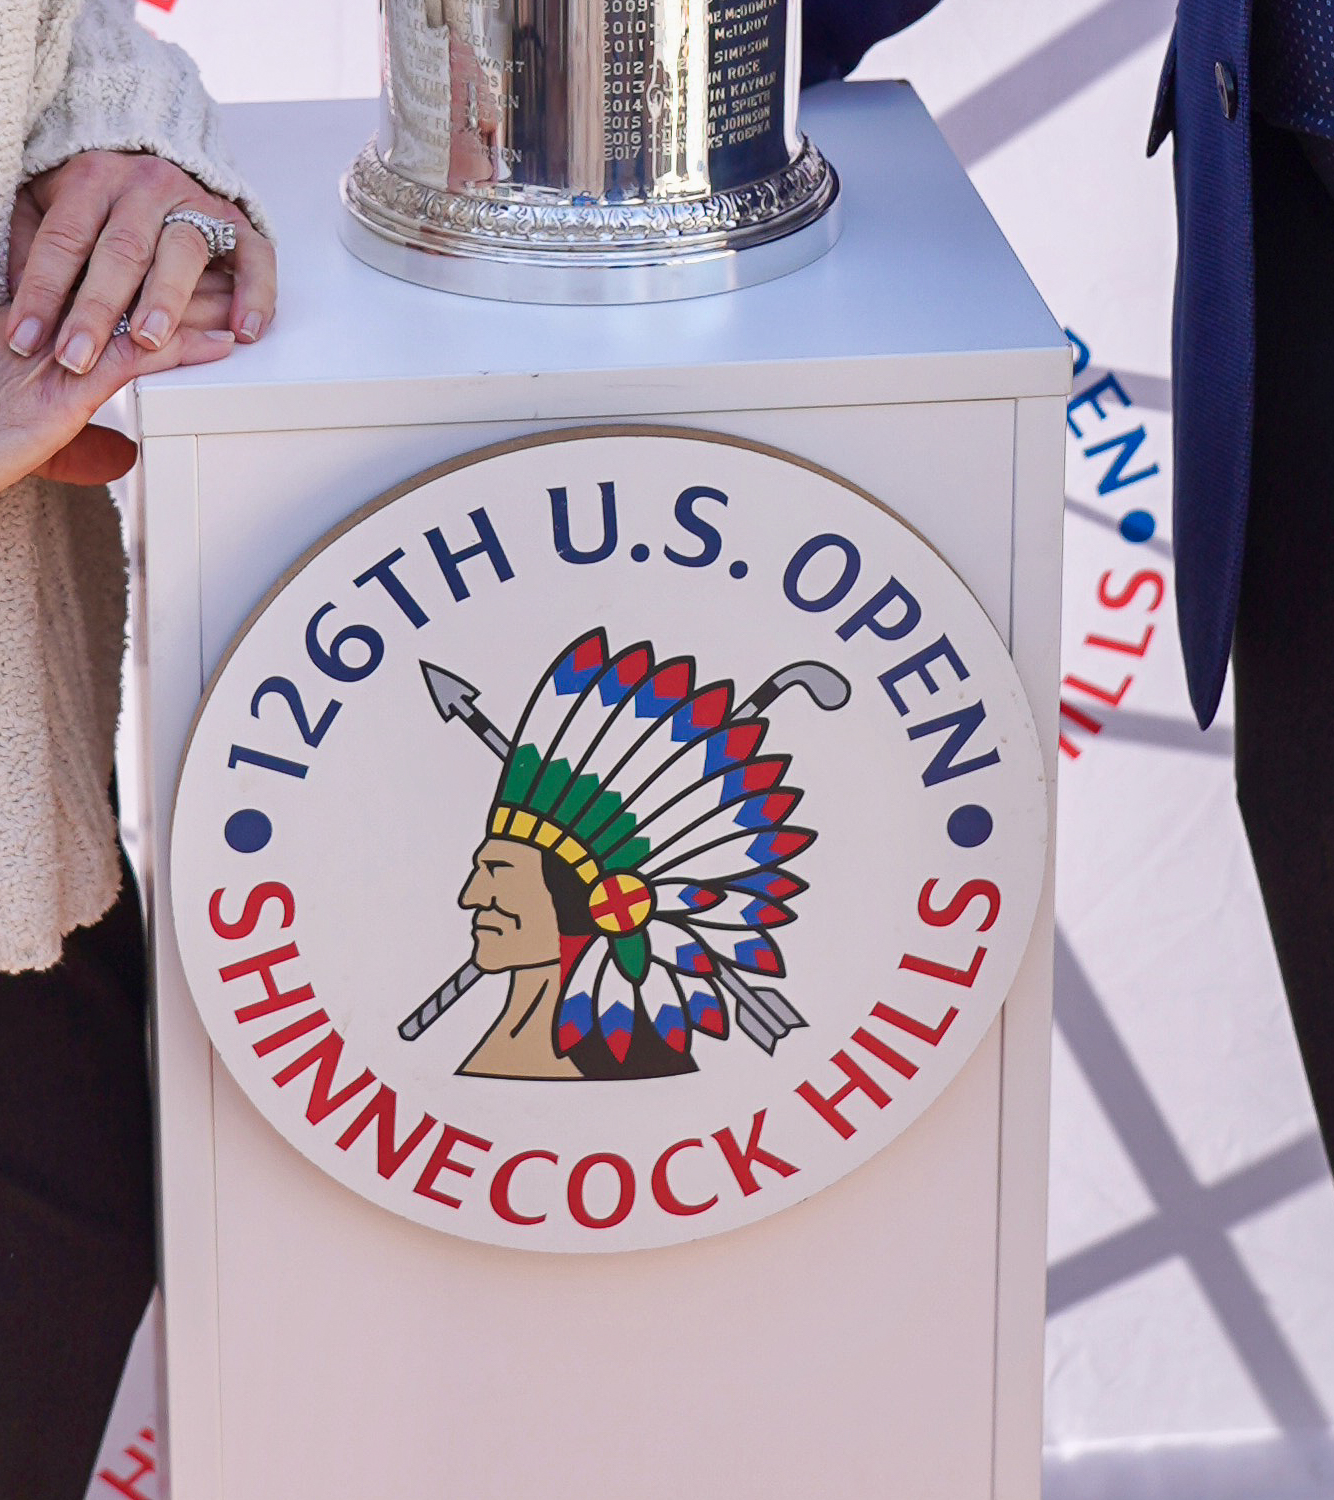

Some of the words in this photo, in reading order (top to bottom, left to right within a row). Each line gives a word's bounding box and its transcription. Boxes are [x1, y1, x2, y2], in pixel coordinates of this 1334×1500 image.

[228, 506, 517, 780] 126TH
[545, 480, 749, 580] U.S.
[783, 532, 1002, 789] OPEN
[1059, 567, 1165, 761] ILLS
[208, 880, 800, 1230] SHINNECOCK
[794, 876, 1002, 1141] HILLS
